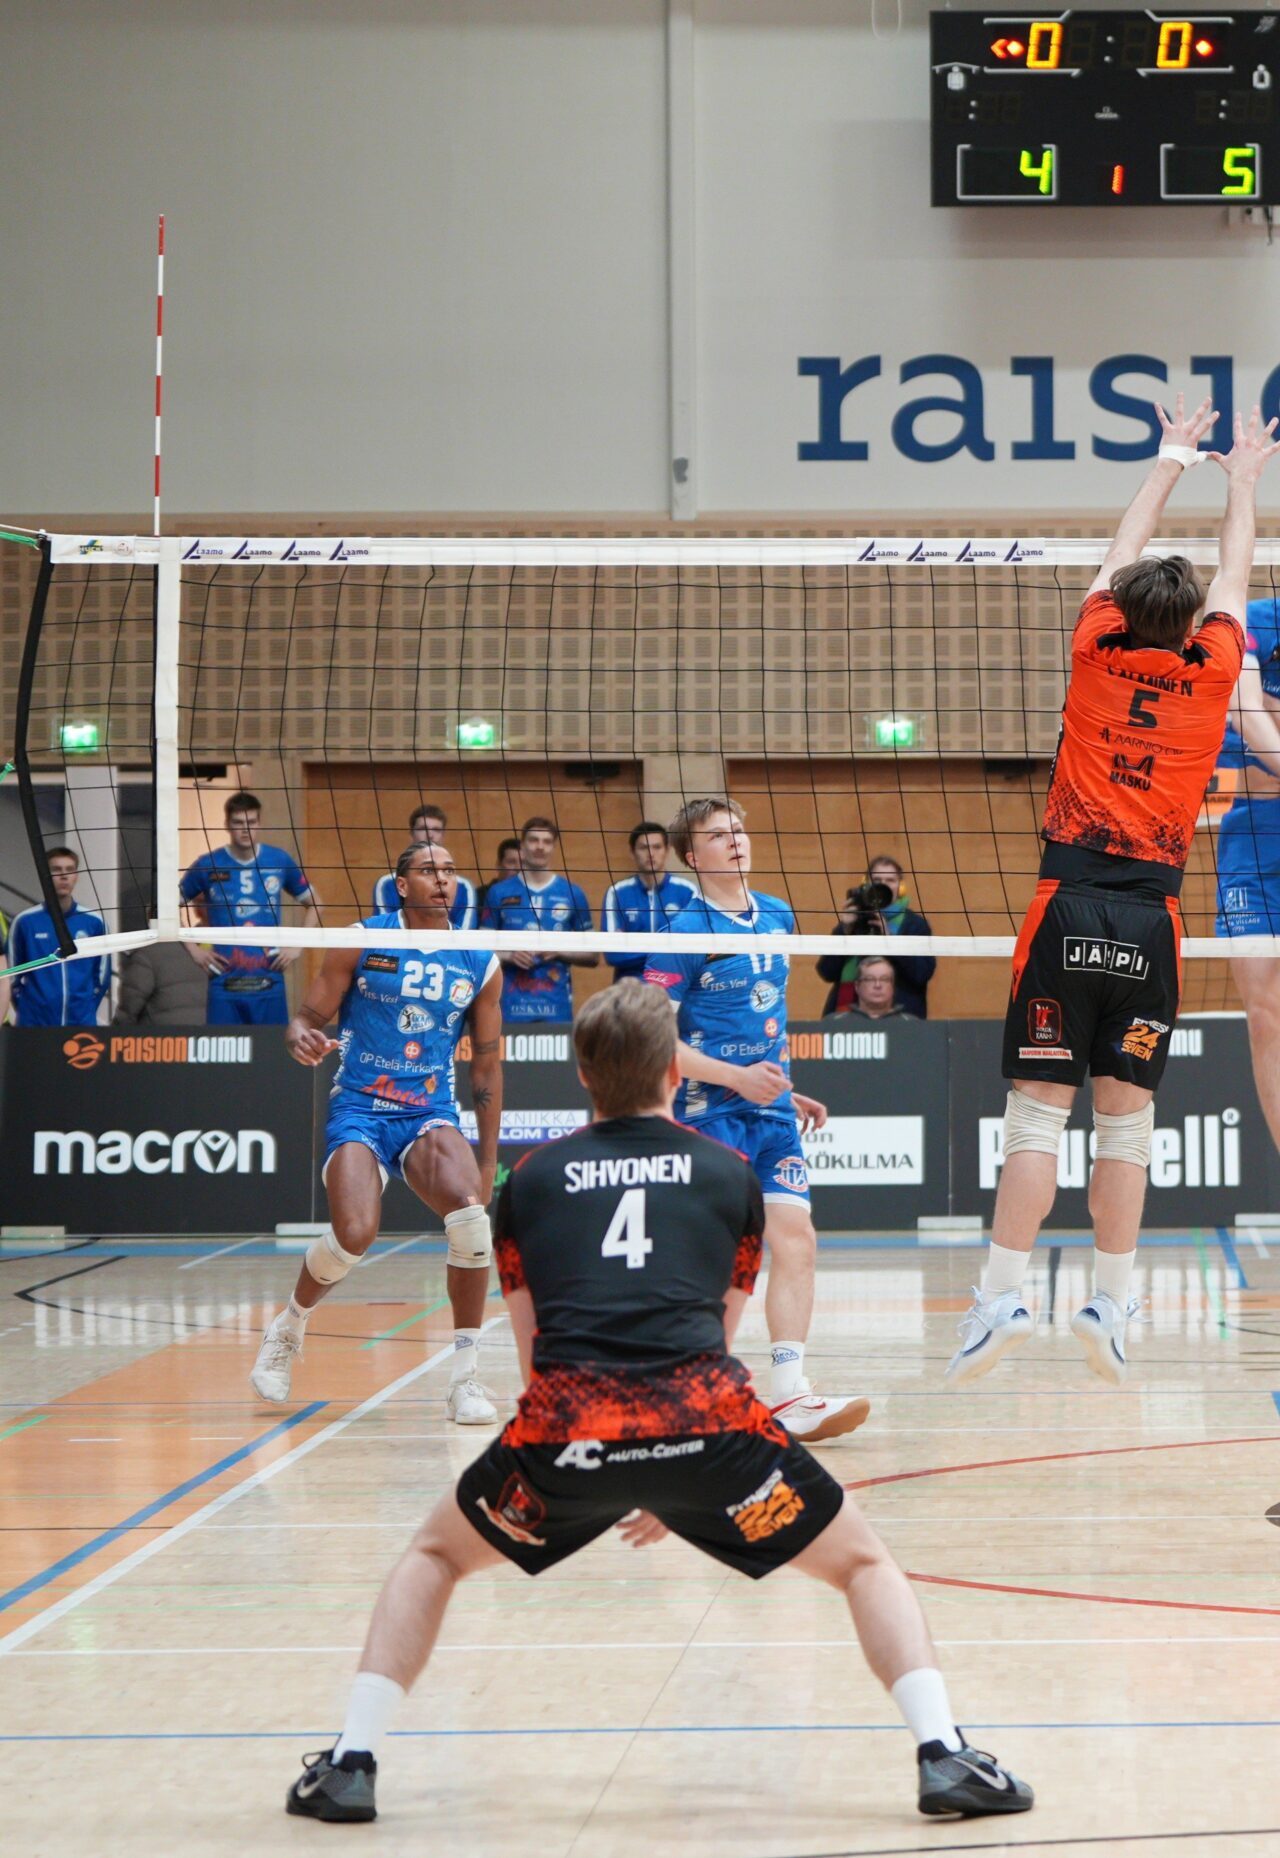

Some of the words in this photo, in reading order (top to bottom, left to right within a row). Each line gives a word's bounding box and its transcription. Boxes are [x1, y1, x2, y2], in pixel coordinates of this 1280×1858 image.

[1026, 22, 1063, 69] 0
[1156, 22, 1193, 69] 0
[1019, 149, 1053, 195] 4
[1111, 164, 1124, 194] 1
[1221, 147, 1255, 195] 5
[1127, 689, 1160, 729] 5
[1110, 771, 1152, 792] MASKU
[240, 870, 255, 895] 5
[400, 960, 444, 1001] 23
[1127, 1023, 1161, 1050] 24
[360, 1052, 375, 1064] OP
[33, 1129, 277, 1175] macron
[564, 1154, 692, 1193] SIHVONEN
[601, 1188, 653, 1269] 4
[554, 1439, 604, 1470] AC
